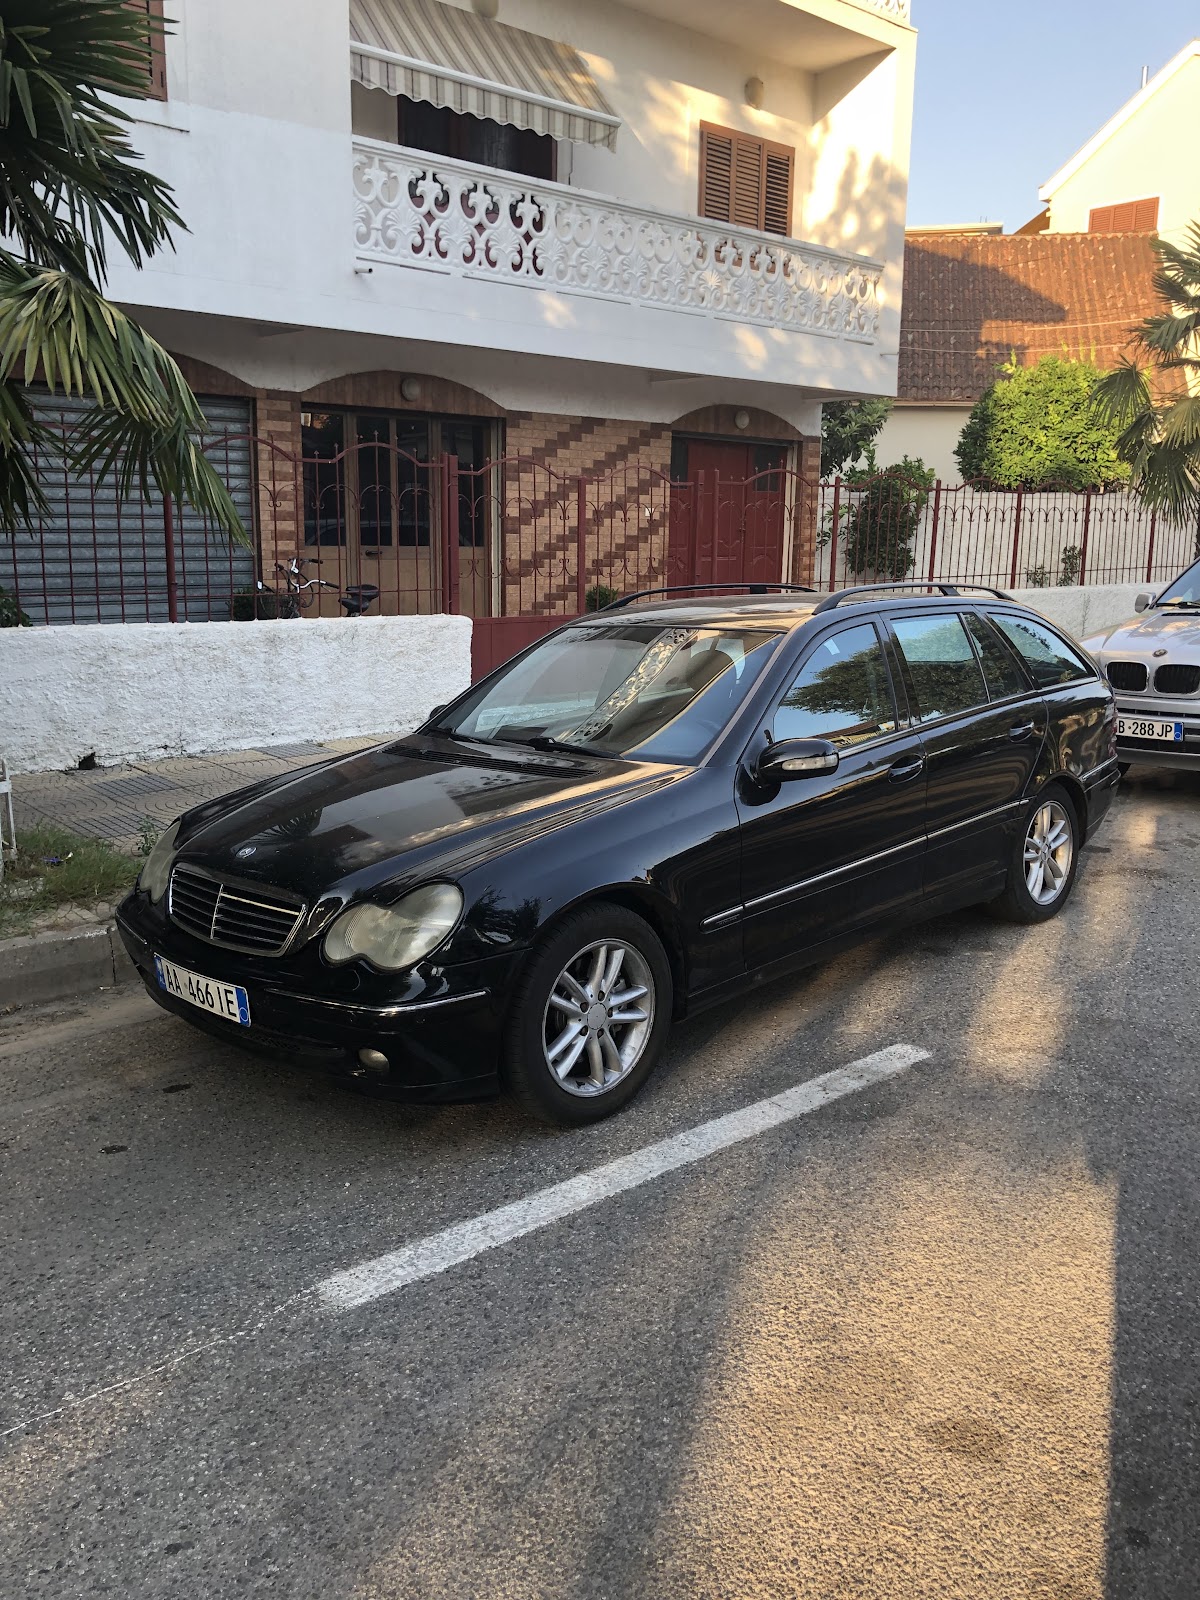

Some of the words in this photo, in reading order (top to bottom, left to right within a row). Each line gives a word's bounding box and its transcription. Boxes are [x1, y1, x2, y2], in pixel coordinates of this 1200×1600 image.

[1132, 721, 1155, 737] 288
[1156, 724, 1173, 738] JP
[165, 965, 182, 995] AA
[188, 976, 215, 1008] 466
[217, 986, 237, 1017] IE
